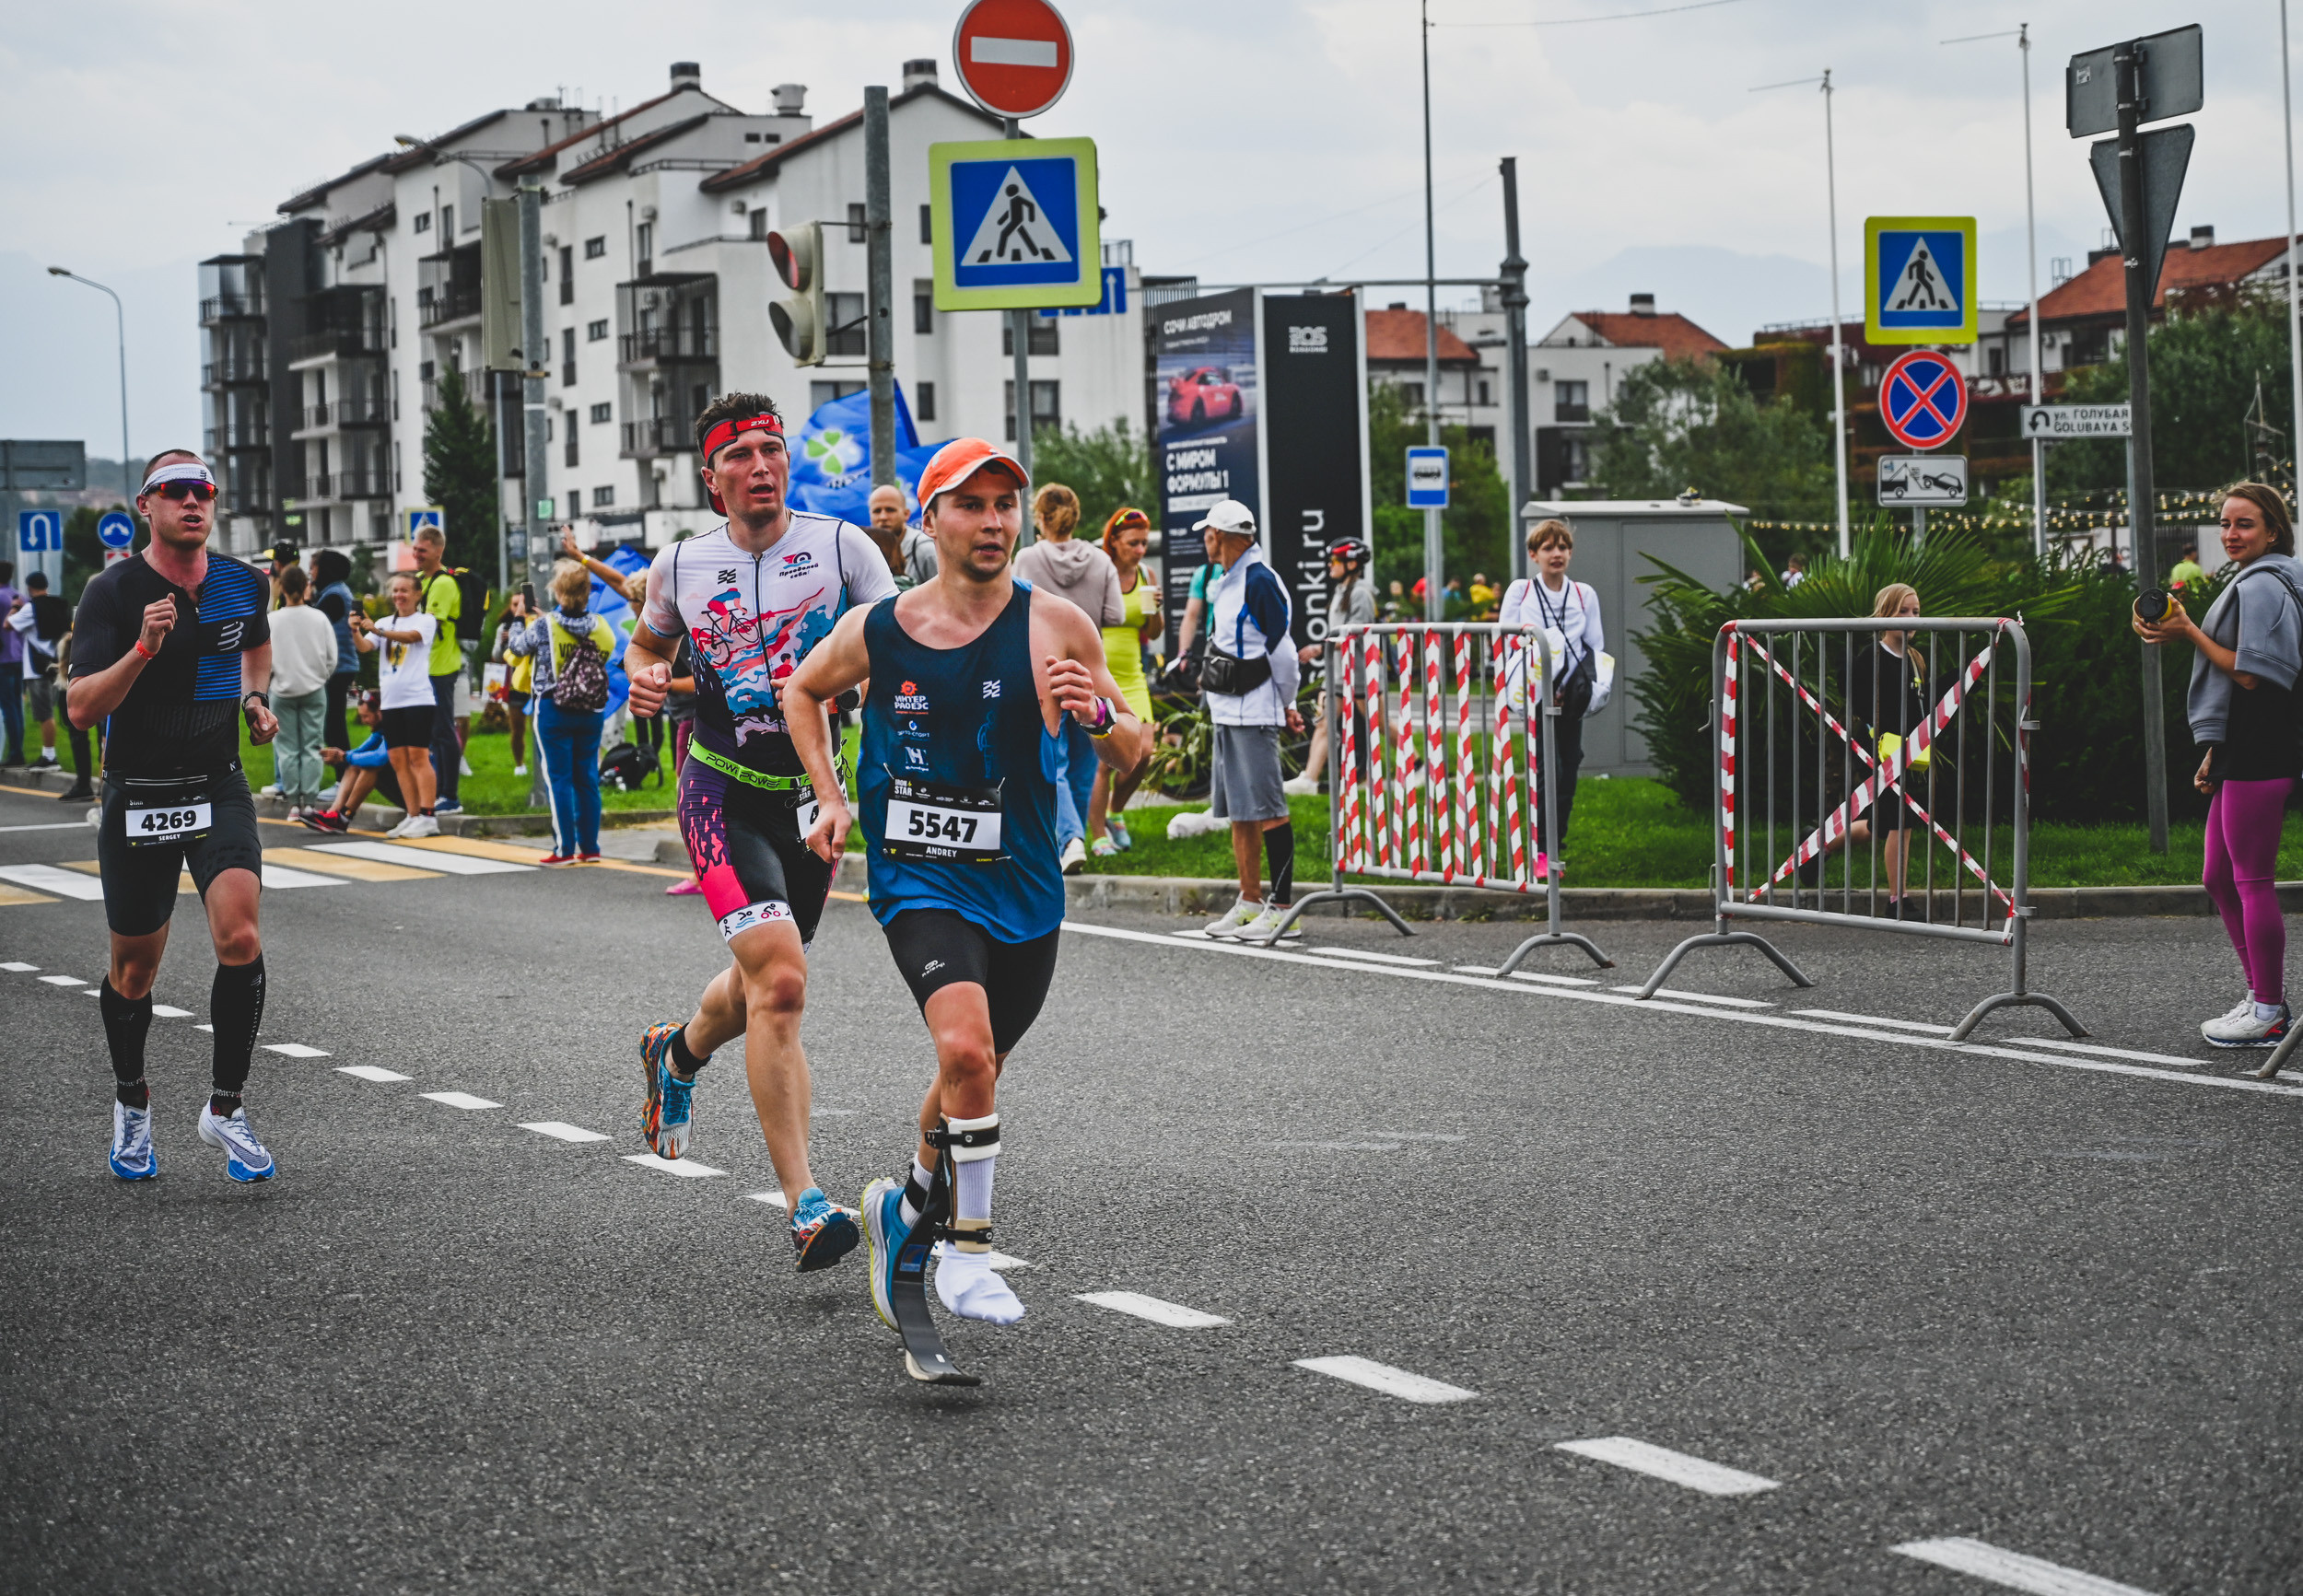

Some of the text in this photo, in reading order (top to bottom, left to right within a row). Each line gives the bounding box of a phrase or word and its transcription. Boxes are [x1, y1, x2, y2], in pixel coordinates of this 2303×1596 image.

[2073, 409, 2129, 419] ГОЛУБАЯ
[2053, 421, 2131, 433] GOLUBAYA S
[1165, 449, 1216, 472] С МИРОМ
[1166, 470, 1229, 494] ФОРМУЛЫ 1
[894, 695, 926, 704] ИНТЕР
[799, 790, 811, 801] STAR
[894, 786, 912, 797] STAR
[141, 810, 196, 832] 4269
[908, 810, 977, 843] 5547
[158, 833, 181, 842] SERGEY
[926, 846, 957, 857] ANDREY
